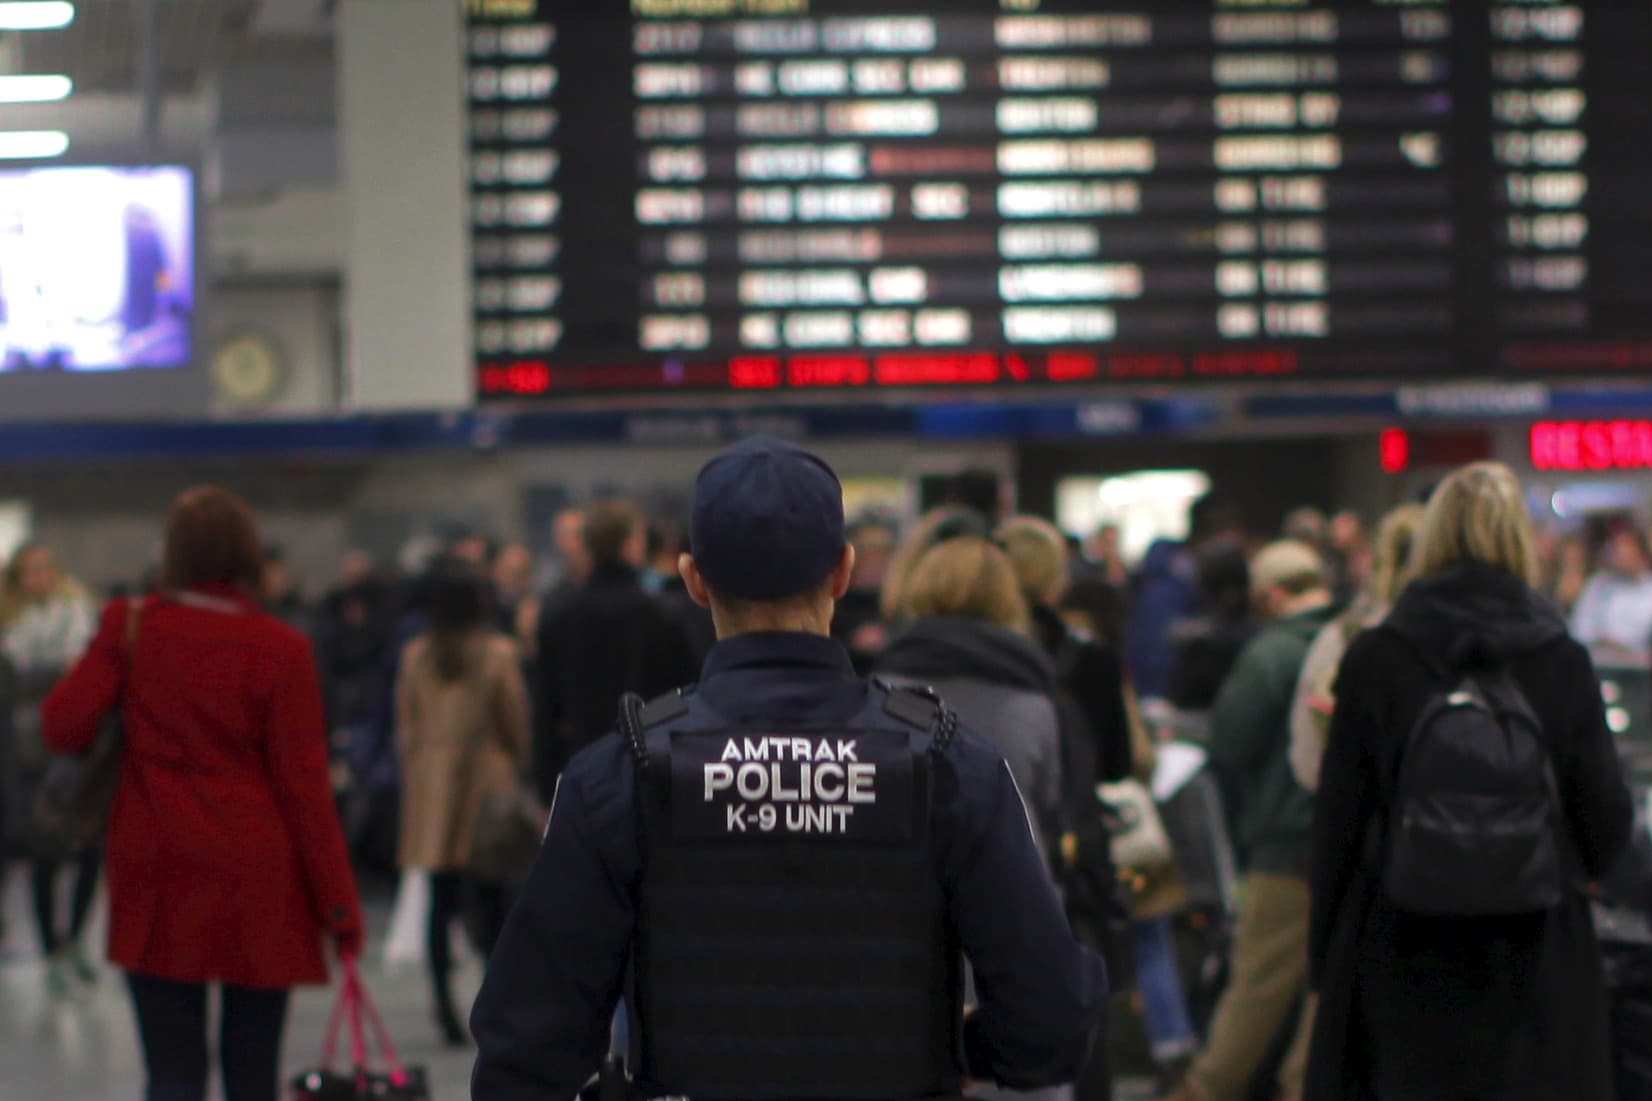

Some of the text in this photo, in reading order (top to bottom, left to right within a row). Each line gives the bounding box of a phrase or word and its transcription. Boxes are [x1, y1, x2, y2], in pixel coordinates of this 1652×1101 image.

[721, 736, 858, 762] AMTRAK
[704, 763, 876, 803] POLICE
[726, 803, 854, 833] K-9 UNIT
